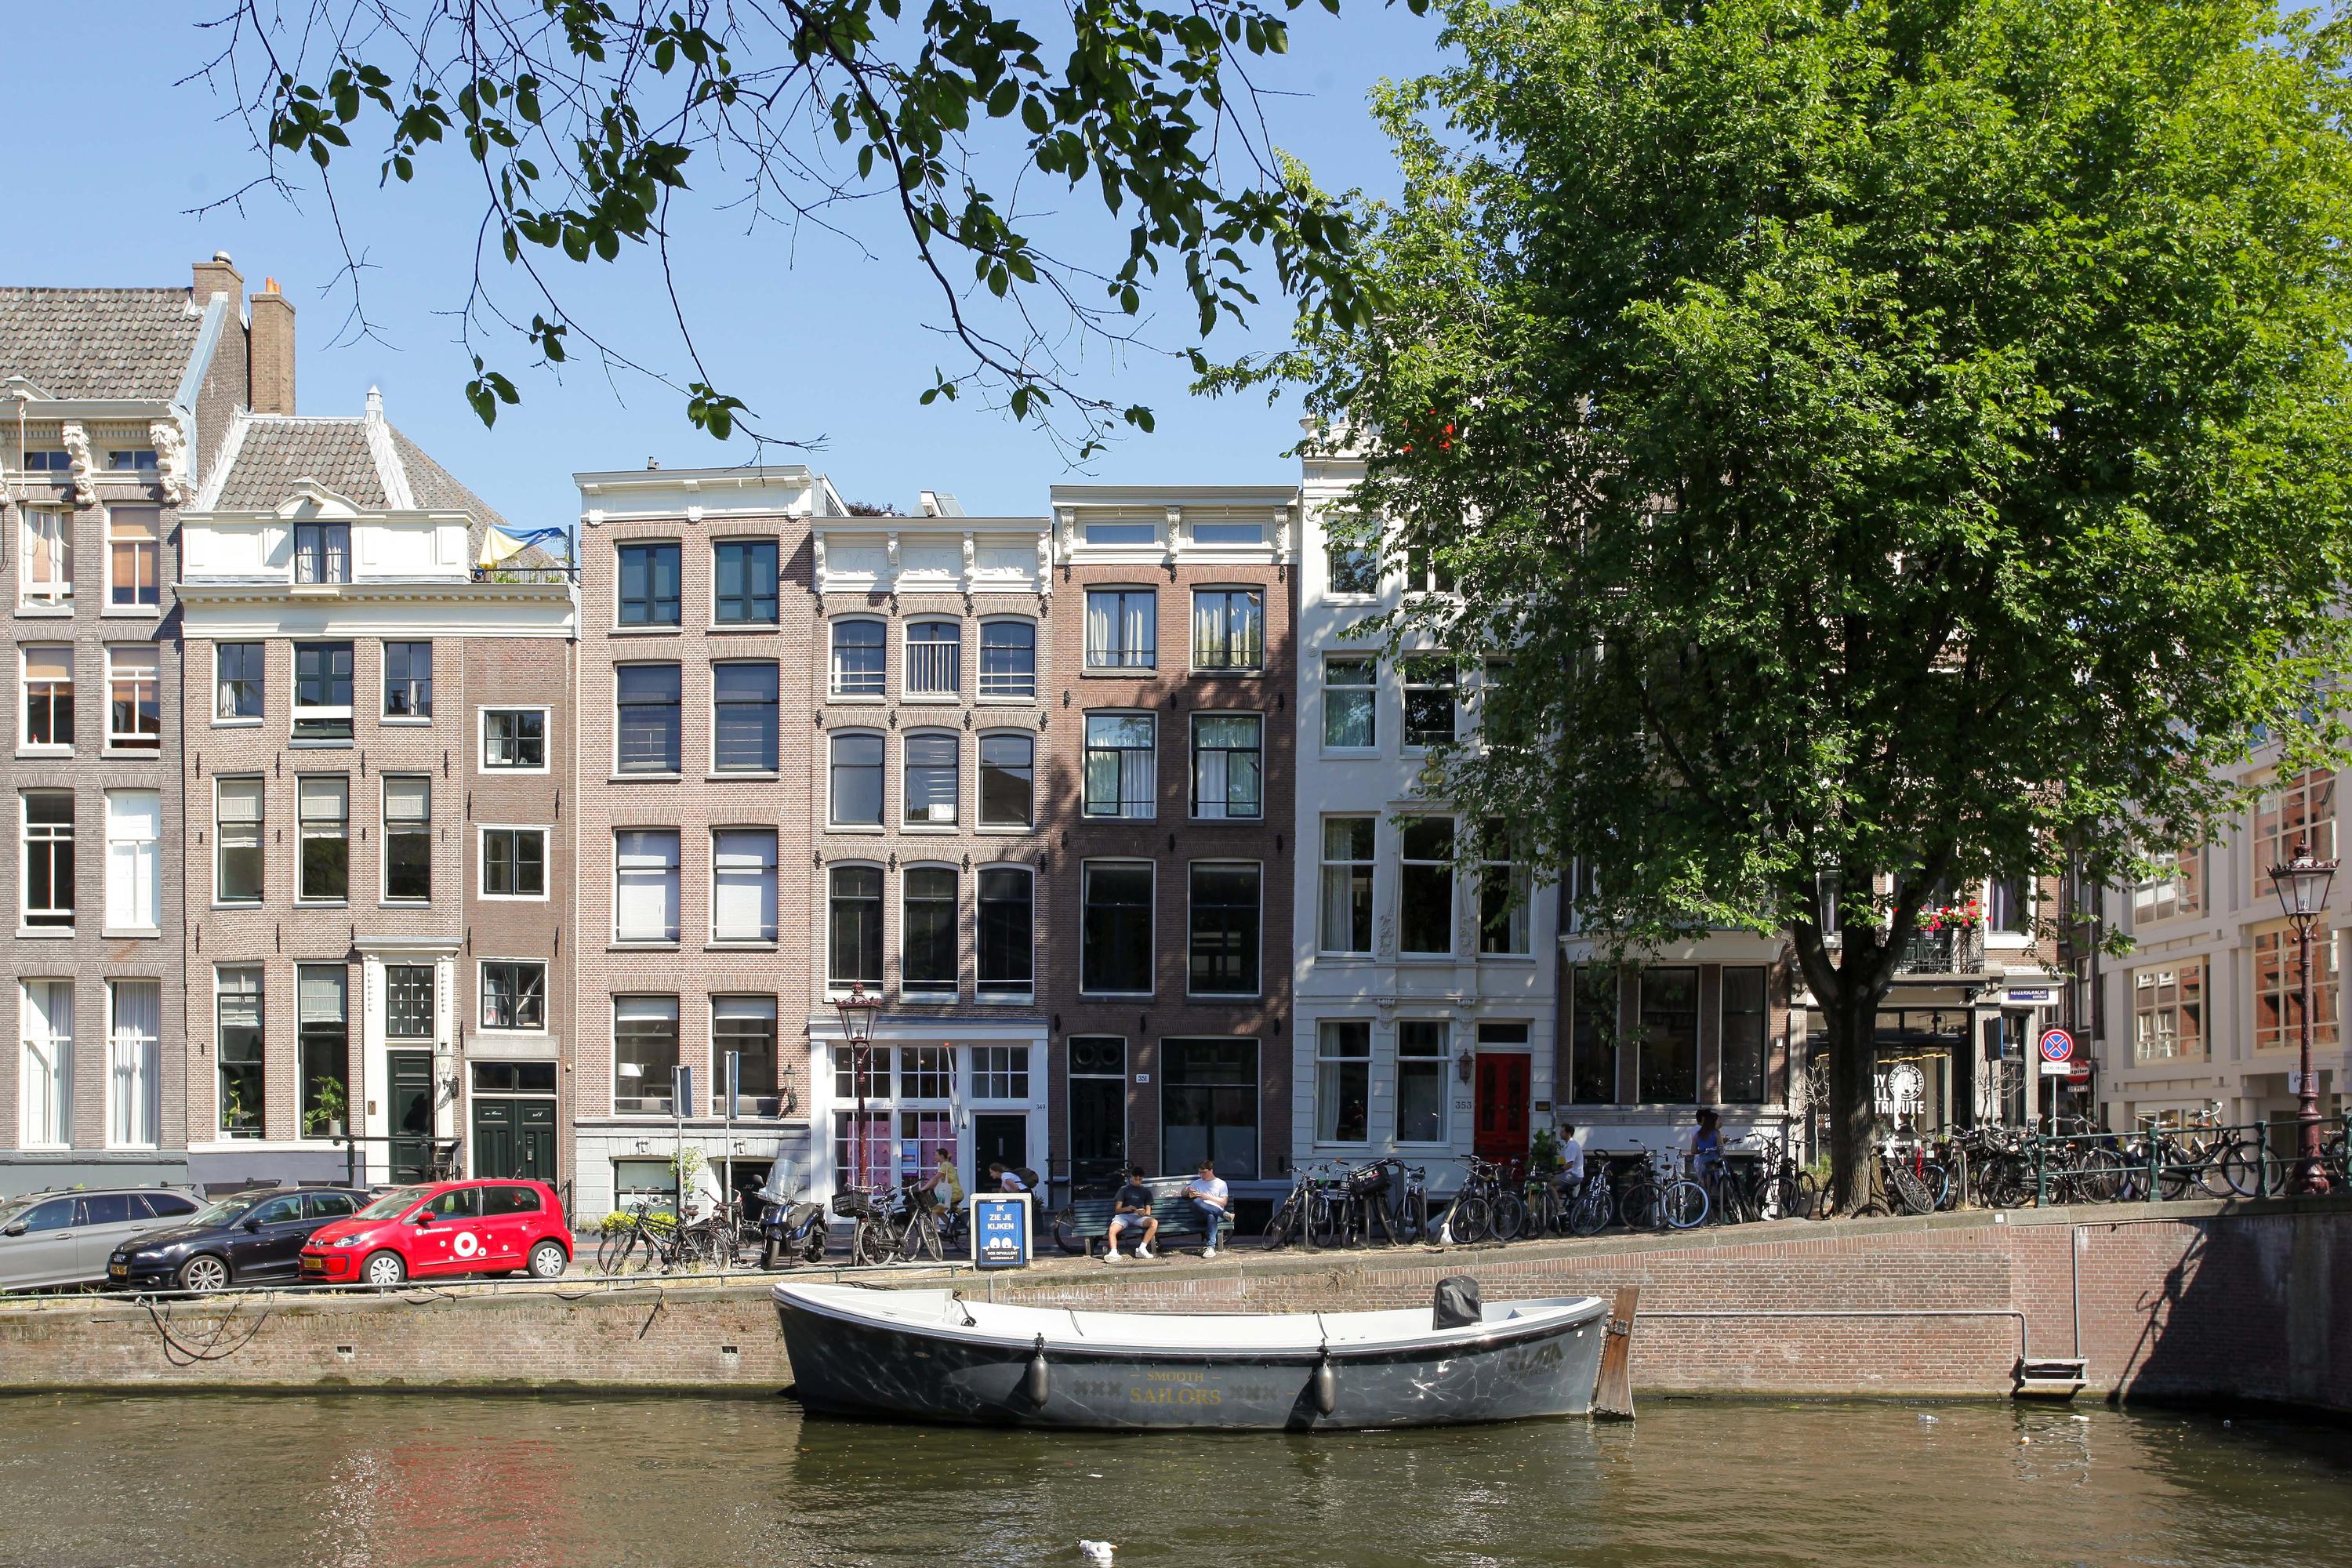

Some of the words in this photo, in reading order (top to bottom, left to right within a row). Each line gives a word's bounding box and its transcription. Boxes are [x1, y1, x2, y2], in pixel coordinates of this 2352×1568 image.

[1455, 1101, 1472, 1109] 353
[1147, 1371, 1204, 1382] SMOOTH
[1129, 1387, 1222, 1406] SAILORS
